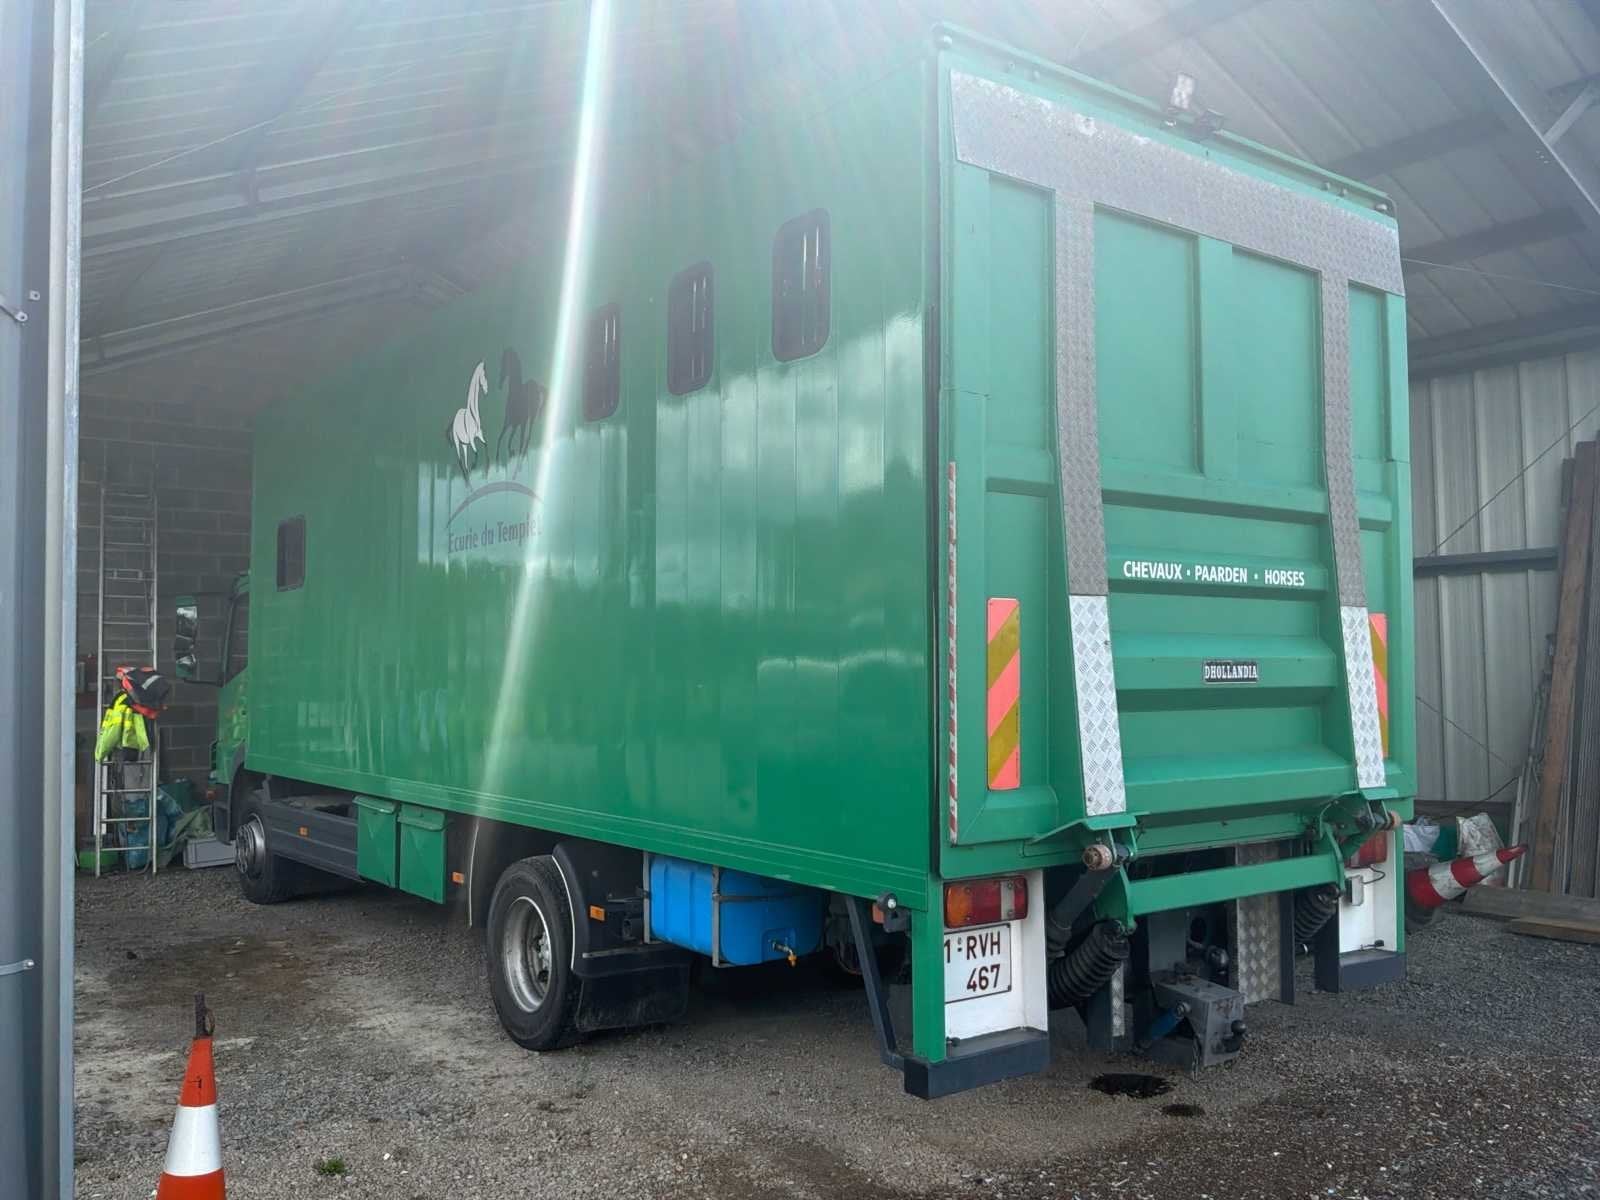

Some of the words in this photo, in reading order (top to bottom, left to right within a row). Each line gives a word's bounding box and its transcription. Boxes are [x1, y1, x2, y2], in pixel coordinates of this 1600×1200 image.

[481, 520, 494, 547] du
[1123, 560, 1183, 580] CHEVAUX
[1194, 564, 1248, 583] PAARDEN
[1264, 569, 1305, 587] HORSES
[1204, 664, 1258, 680] DHOLLANDIA
[966, 963, 1001, 993] 467
